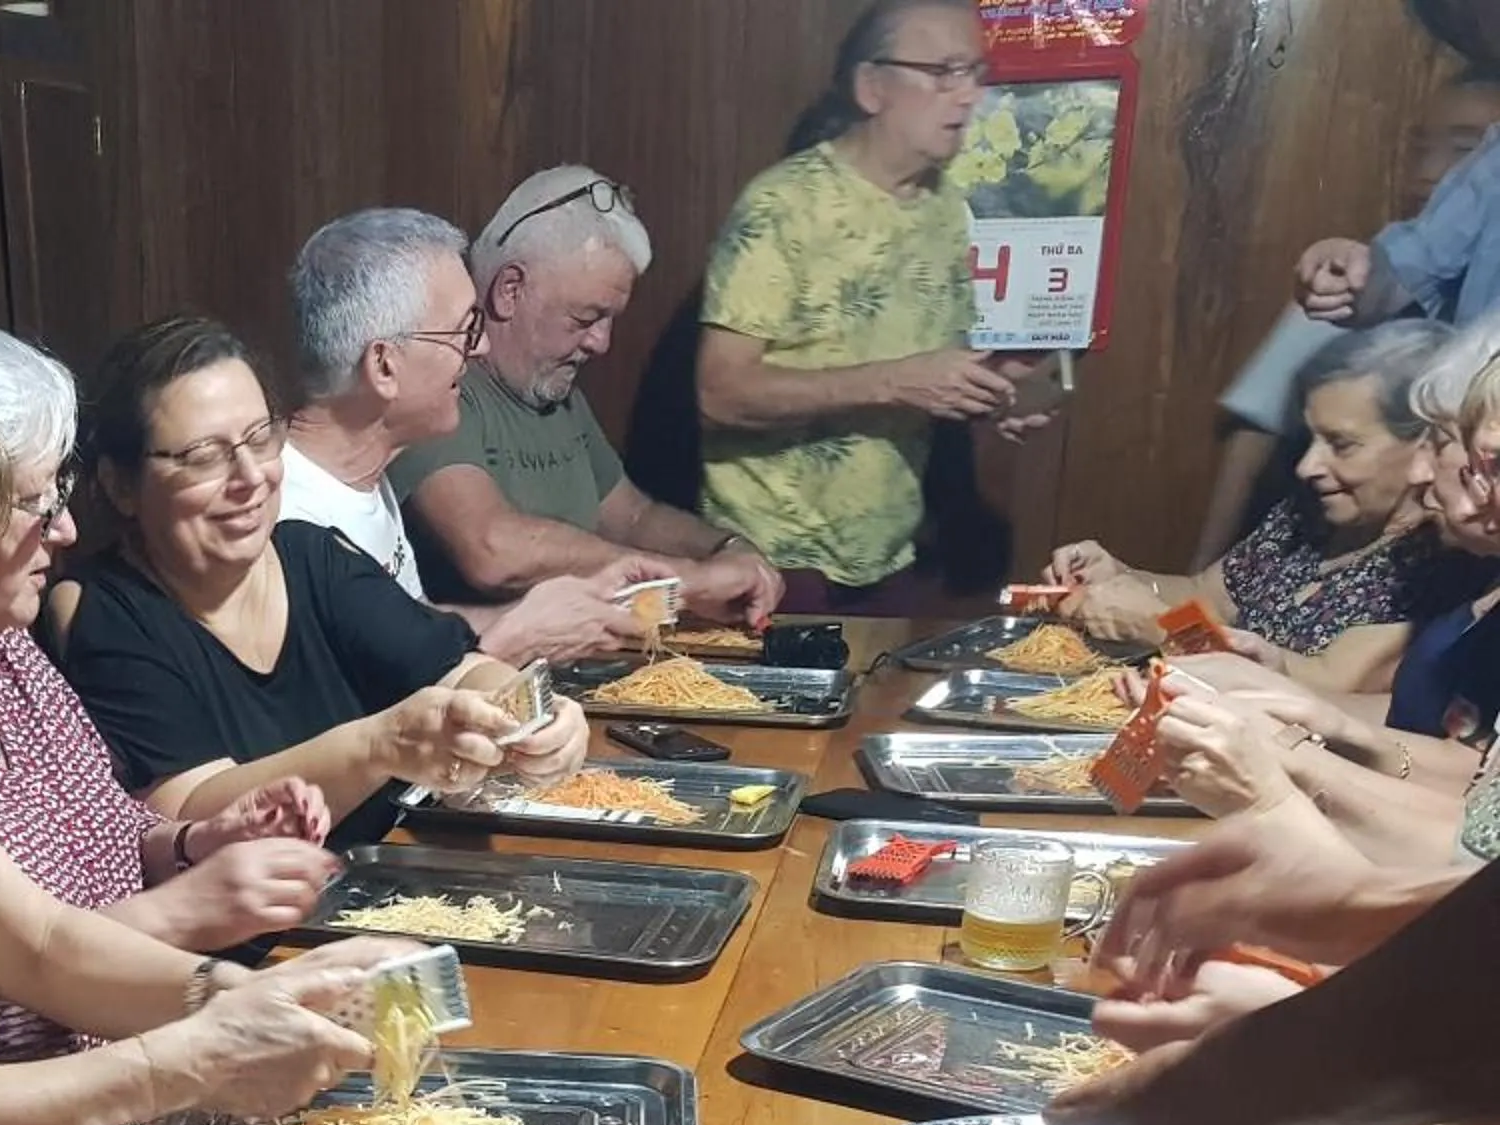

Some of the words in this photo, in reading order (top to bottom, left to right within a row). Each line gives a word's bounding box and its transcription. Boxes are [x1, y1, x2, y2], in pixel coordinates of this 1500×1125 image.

[1041, 241, 1065, 255] THỨ
[1067, 245, 1084, 255] BA
[1048, 267, 1069, 293] 3
